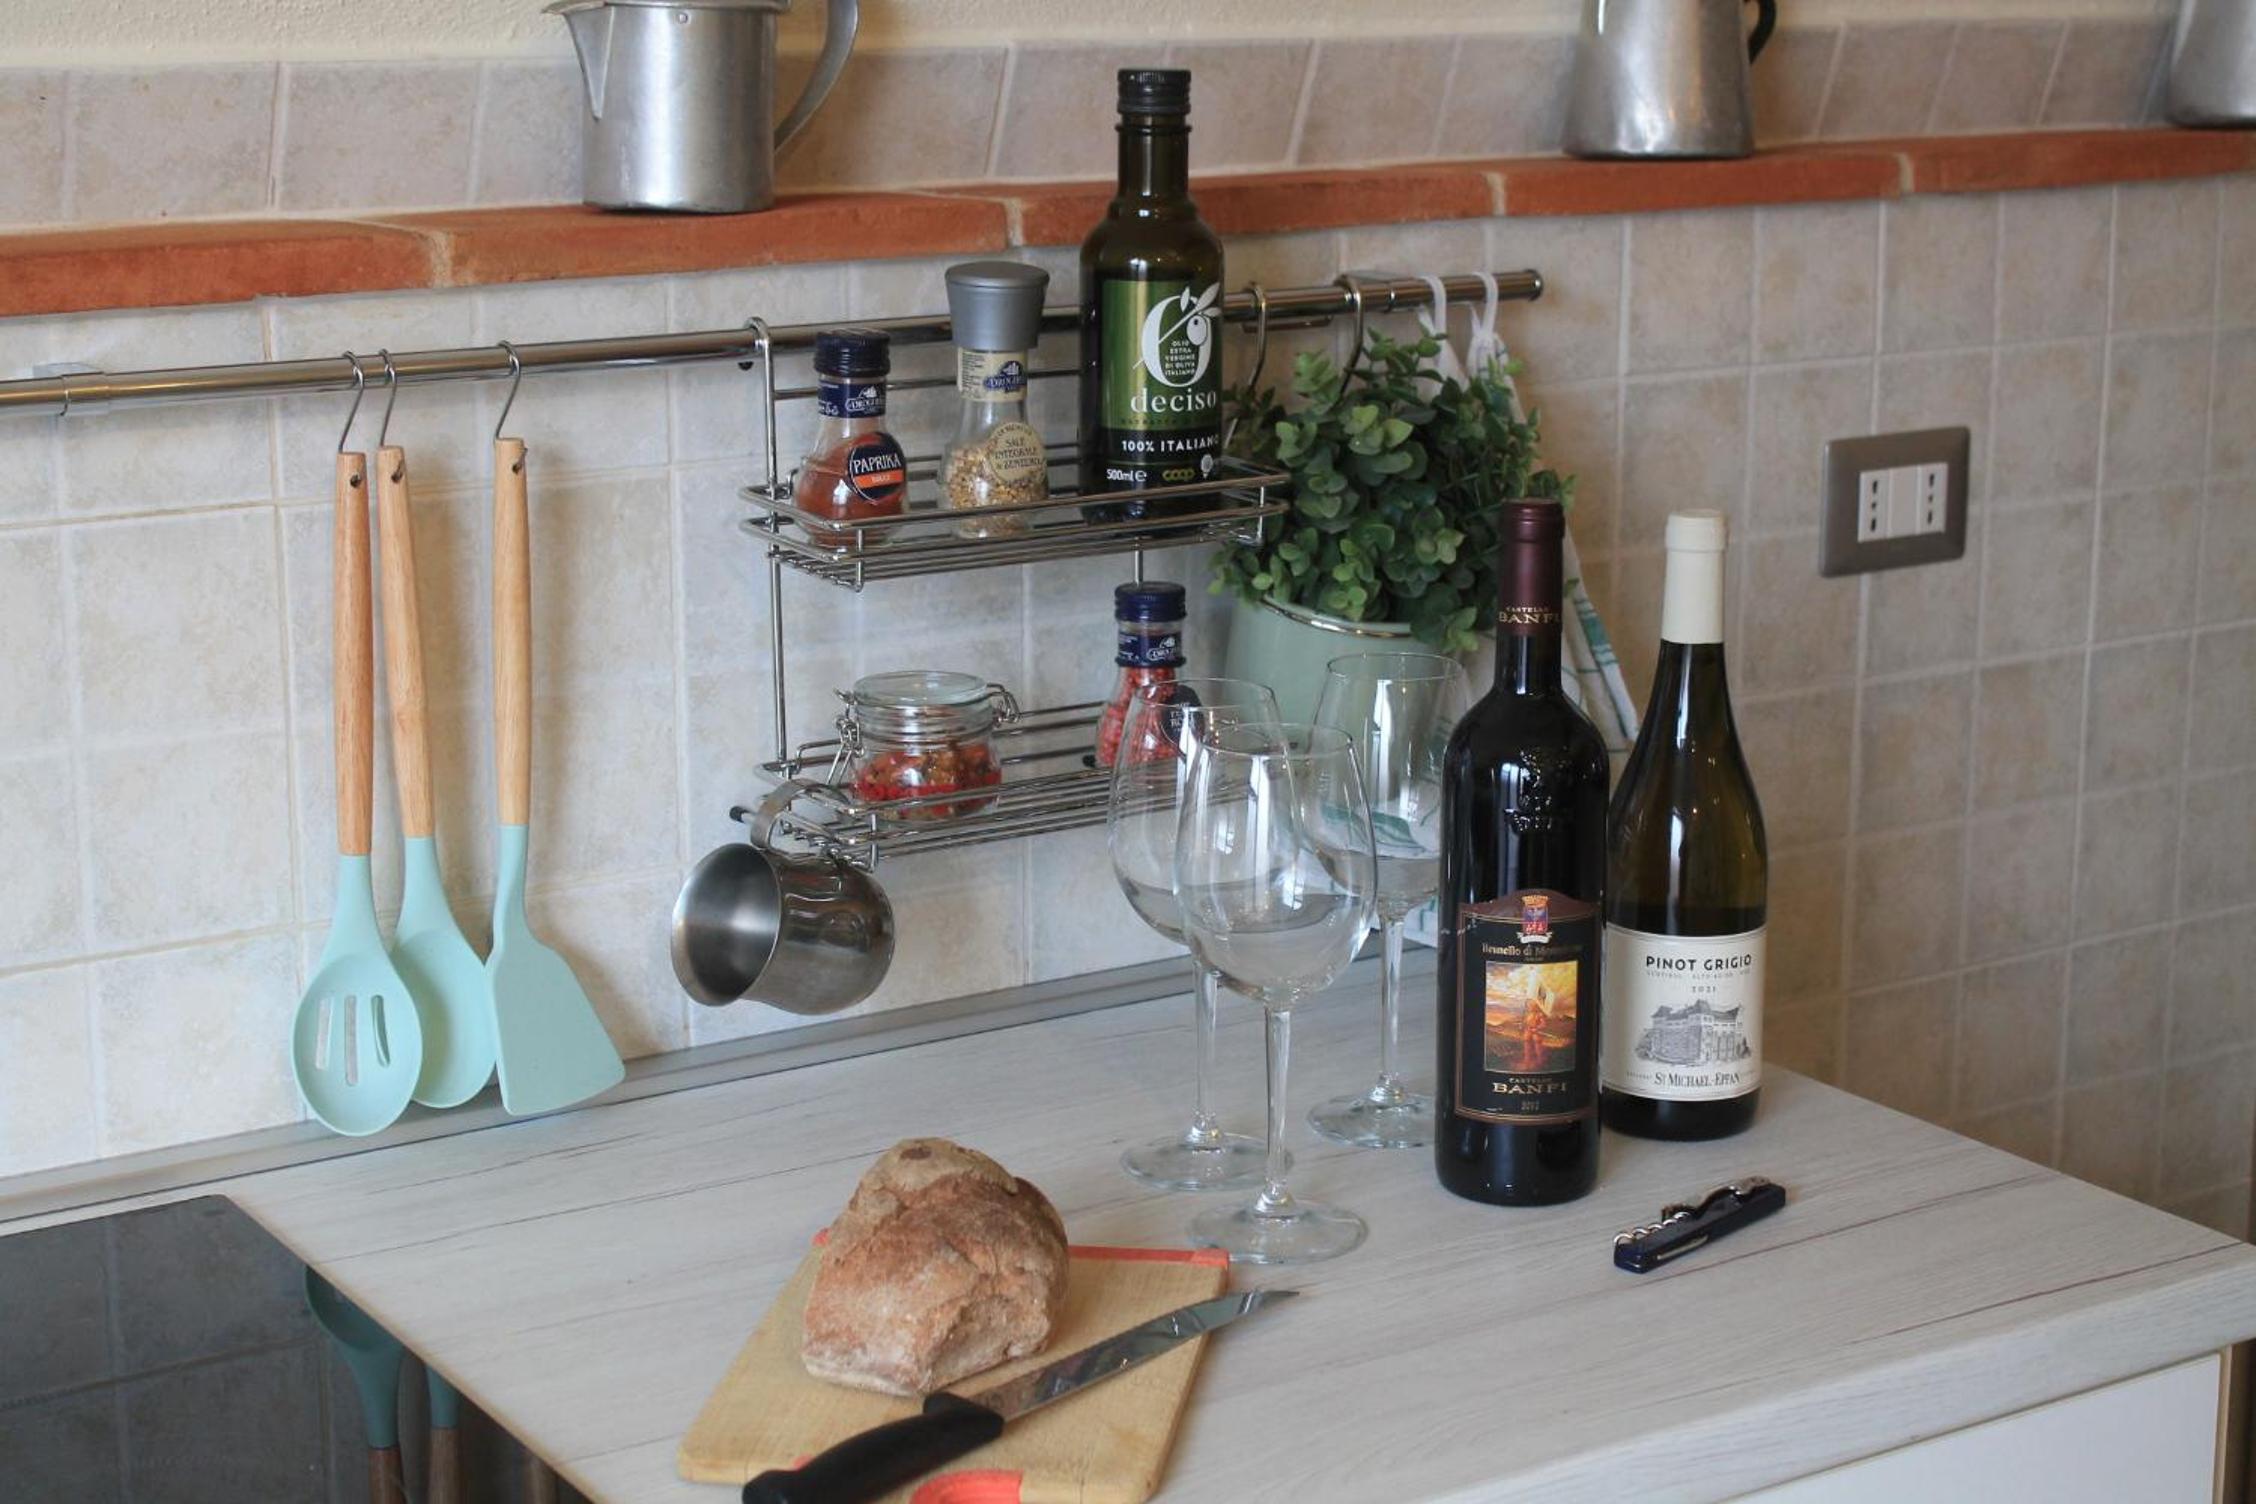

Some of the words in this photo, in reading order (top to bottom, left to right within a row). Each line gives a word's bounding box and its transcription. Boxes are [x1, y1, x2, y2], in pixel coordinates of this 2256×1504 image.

[1130, 387, 1217, 413] deciso
[1121, 440, 1155, 452] 100%
[853, 452, 902, 474] PAPRIKA
[1498, 611, 1560, 624] BANFI
[1646, 955, 1697, 971] PINOT
[1703, 953, 1752, 971] GRIGIO
[1492, 1081, 1568, 1095] BANFI
